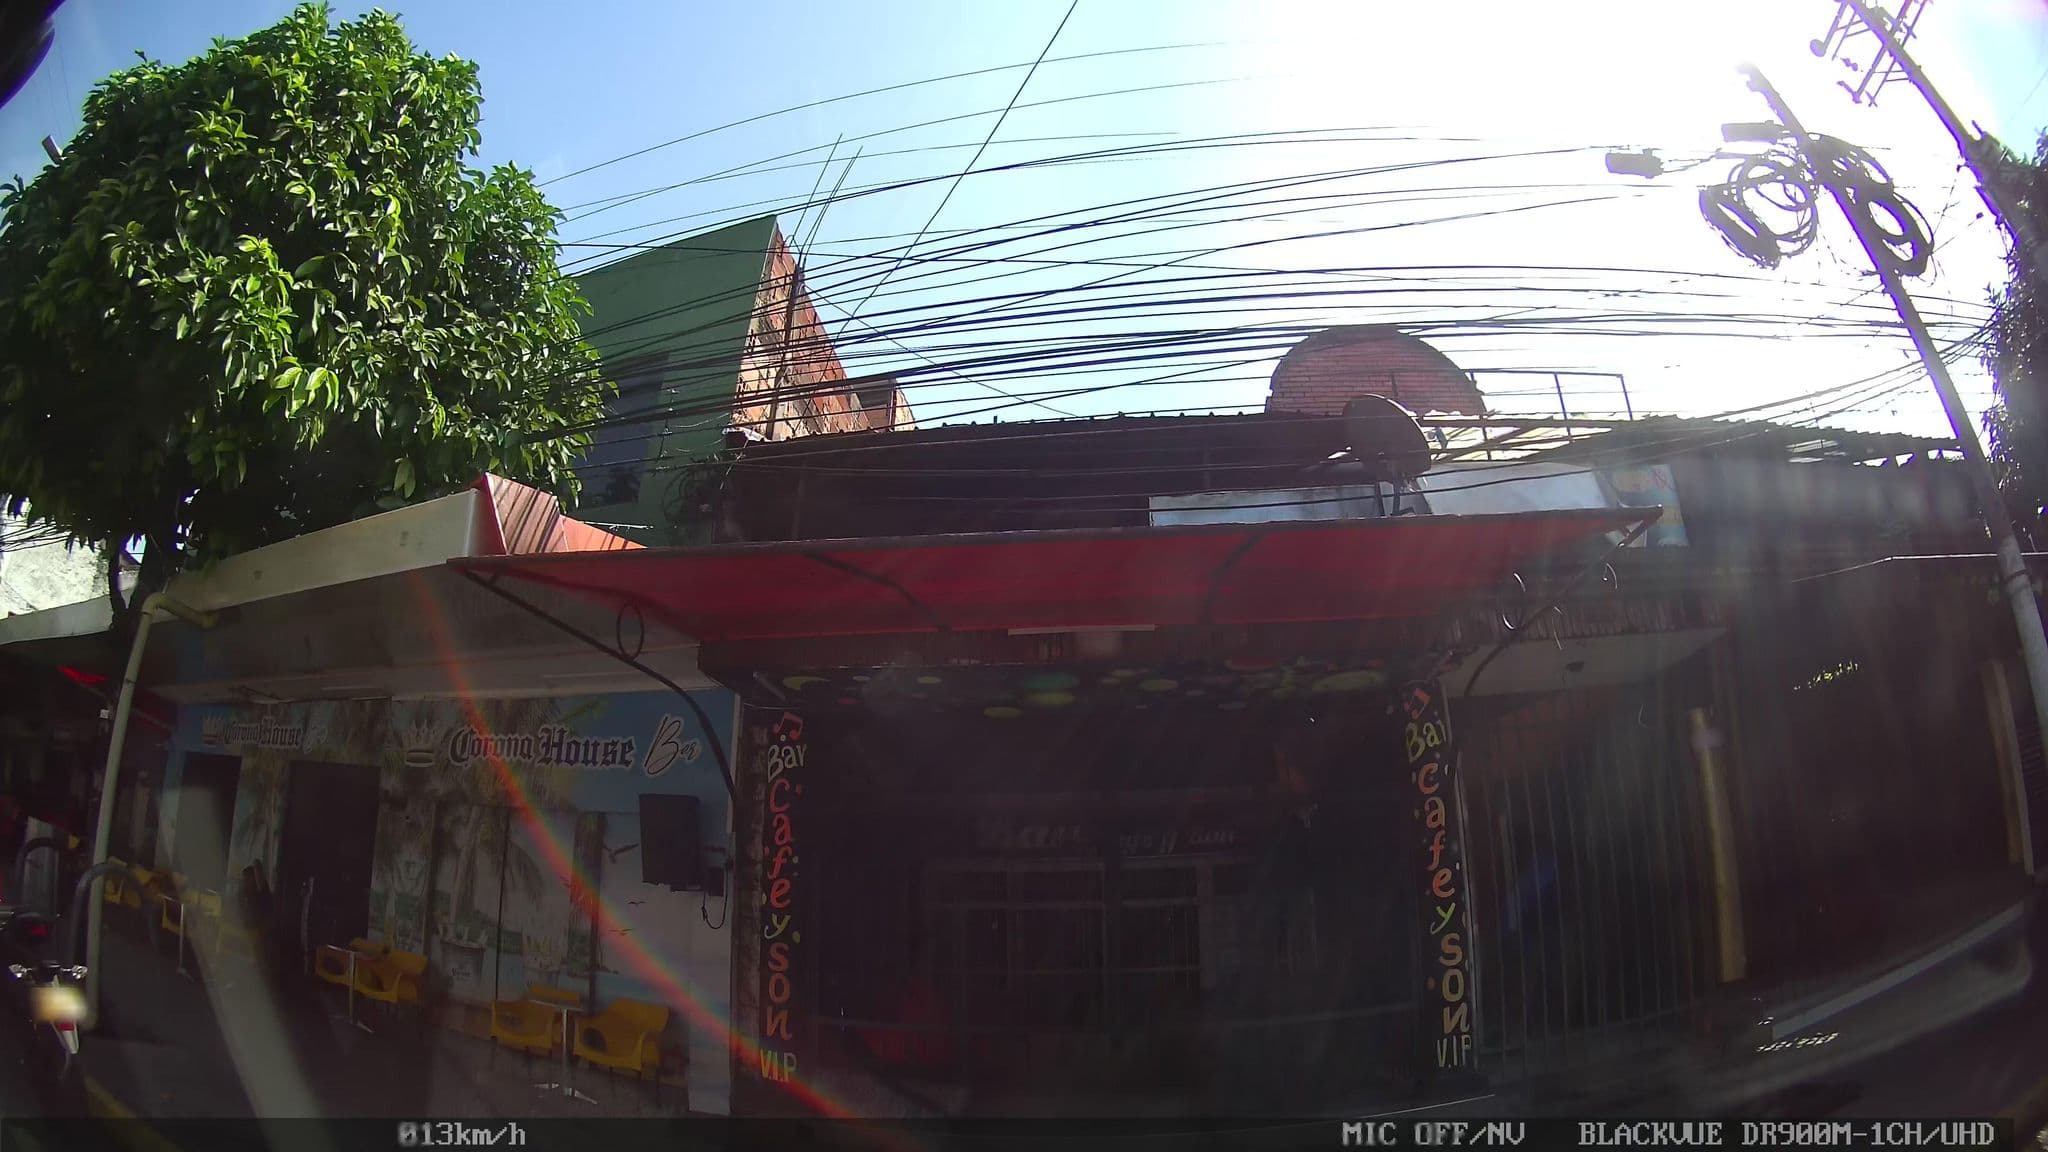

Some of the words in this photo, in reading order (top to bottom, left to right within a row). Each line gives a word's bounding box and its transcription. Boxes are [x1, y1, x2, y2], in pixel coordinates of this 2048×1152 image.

[450, 725, 534, 767] Corona
[537, 724, 636, 768] House
[767, 744, 808, 784] Bar
